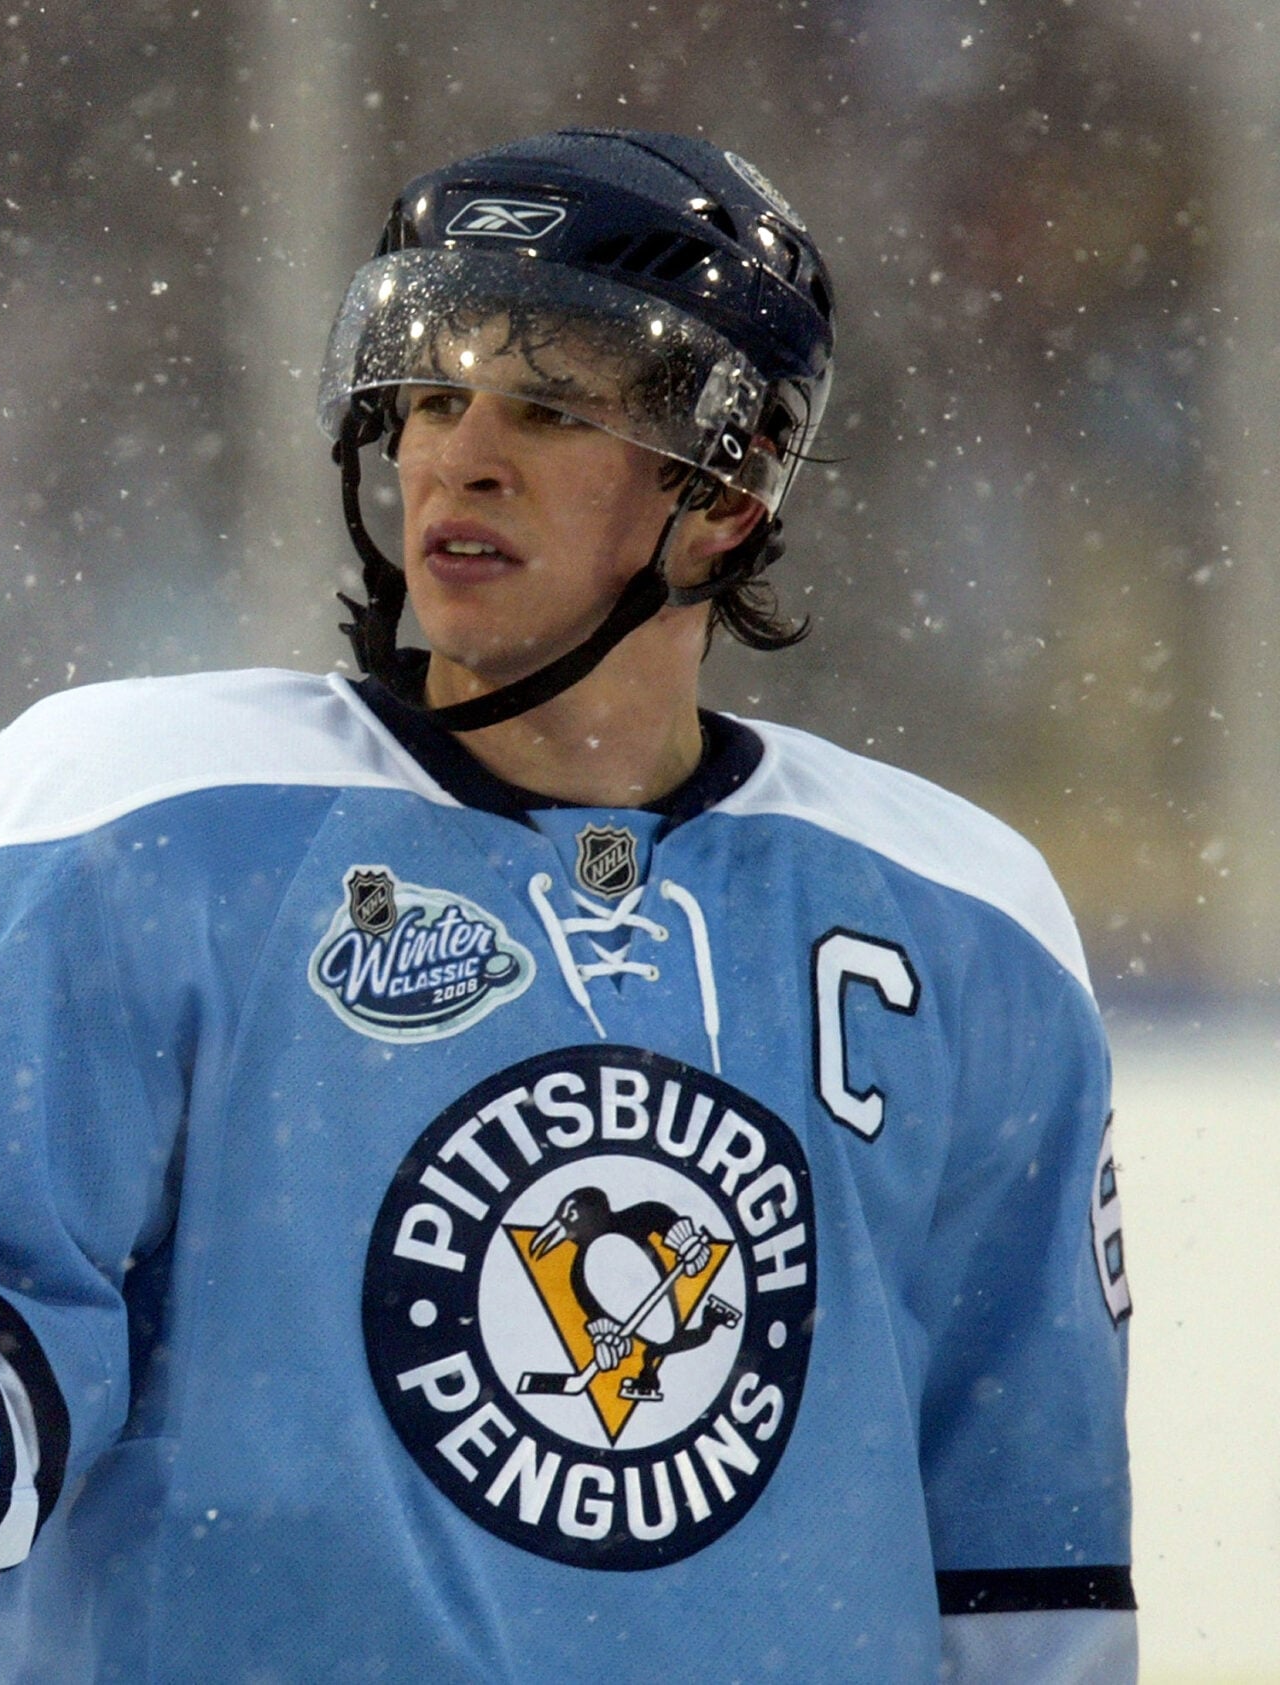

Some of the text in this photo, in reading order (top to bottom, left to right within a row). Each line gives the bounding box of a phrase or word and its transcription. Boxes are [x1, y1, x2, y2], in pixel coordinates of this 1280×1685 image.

[591, 844, 628, 882] NHL
[320, 905, 493, 1002] Winter
[388, 957, 481, 998] CLASSIC
[431, 977, 479, 1005] 2008
[811, 925, 921, 1143] C
[393, 1065, 807, 1293] PITTSBURGH
[396, 1351, 785, 1542] PENGUINS
